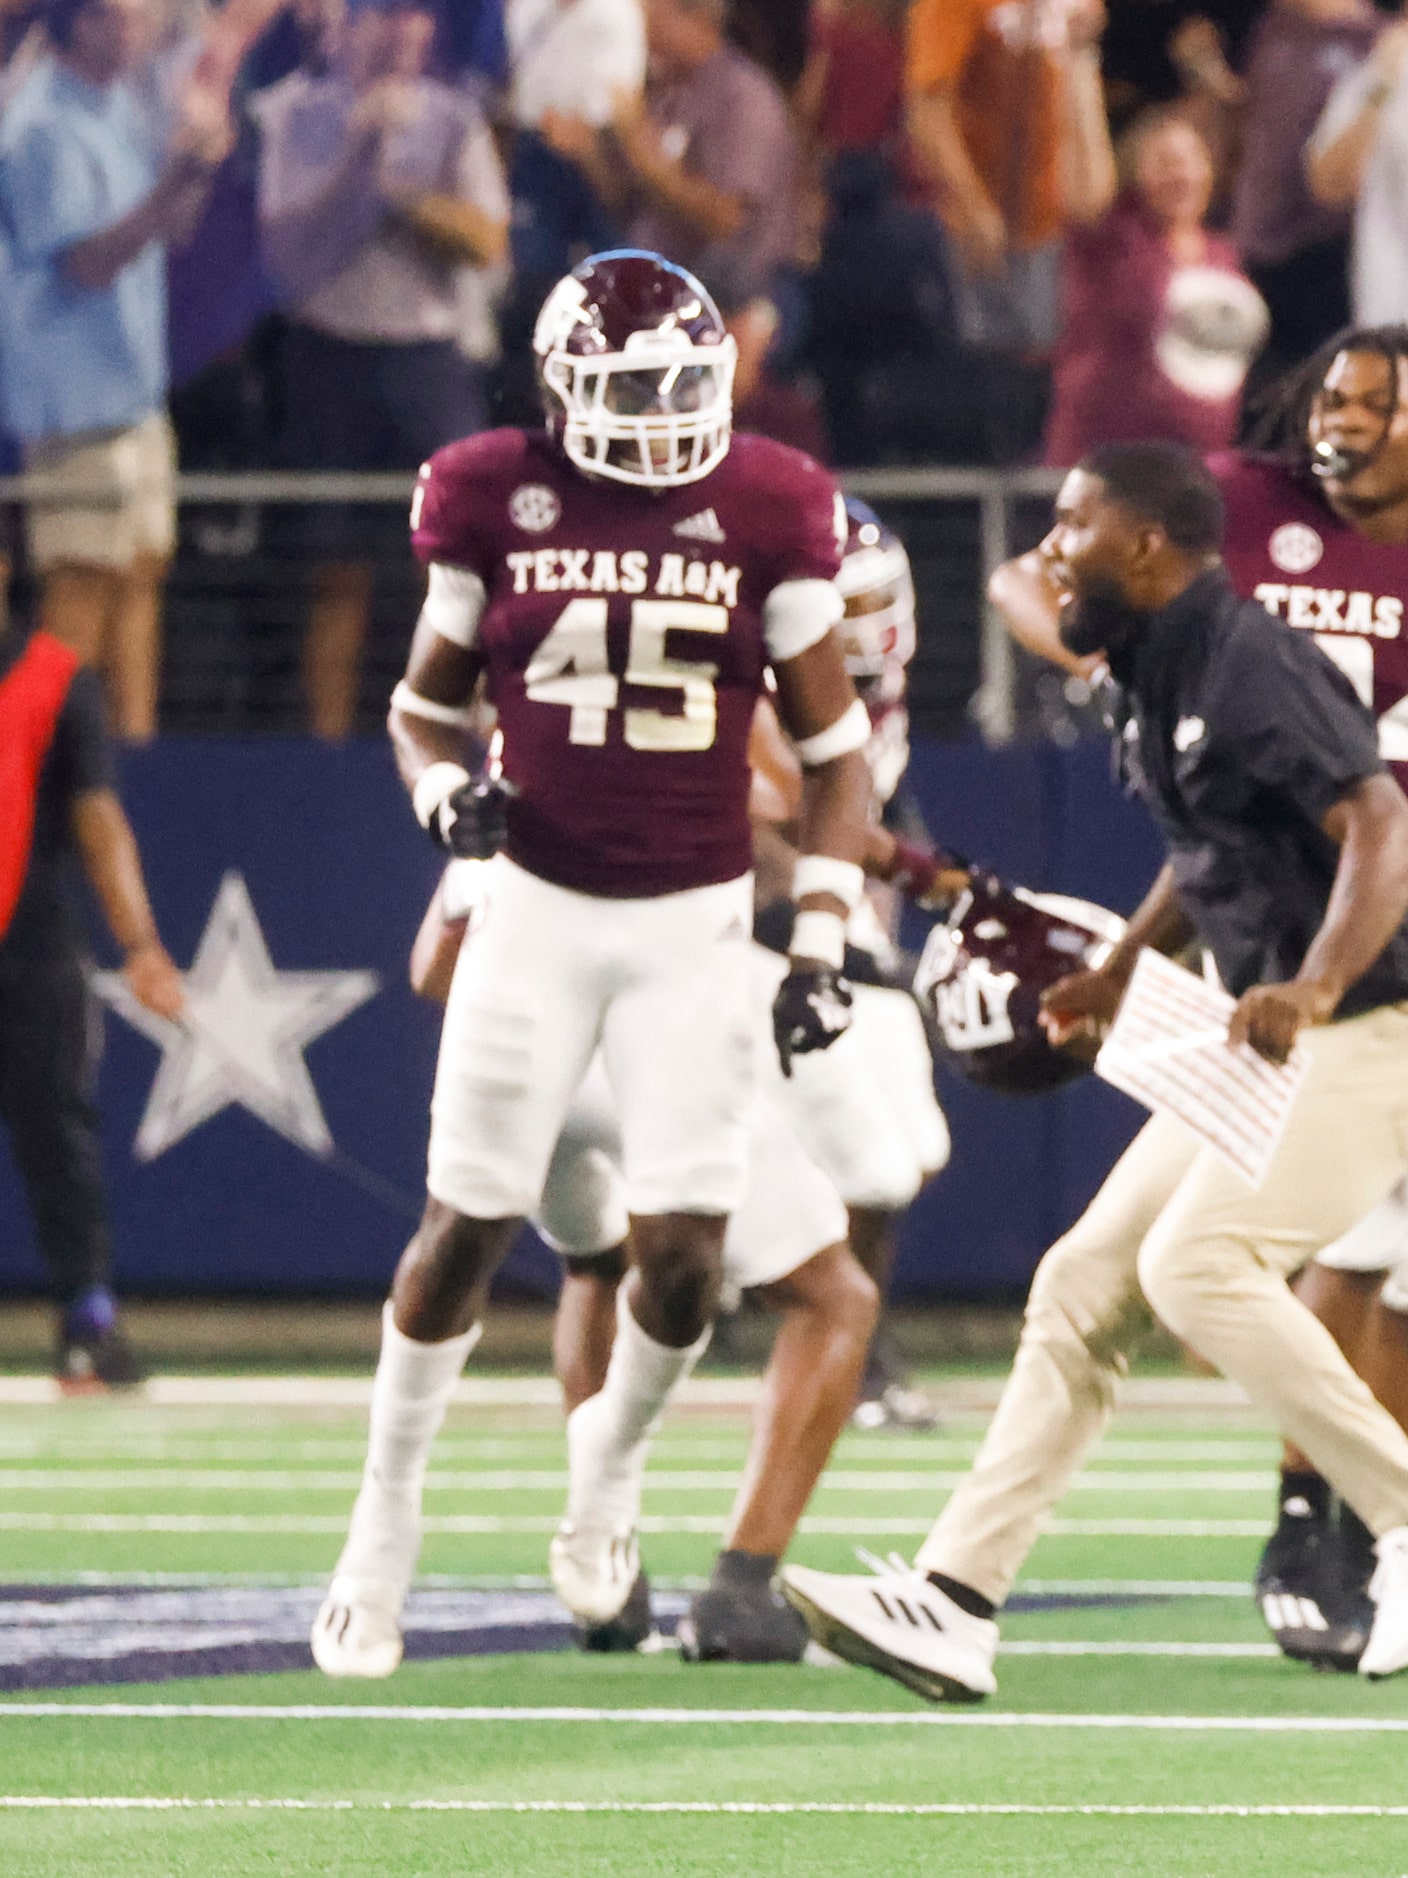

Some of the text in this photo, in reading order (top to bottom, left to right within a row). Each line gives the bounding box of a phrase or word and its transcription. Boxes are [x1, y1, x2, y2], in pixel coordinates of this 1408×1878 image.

[507, 548, 742, 608] TEXAS A&M
[1253, 582, 1404, 639] TEXAS
[523, 598, 728, 752] 45
